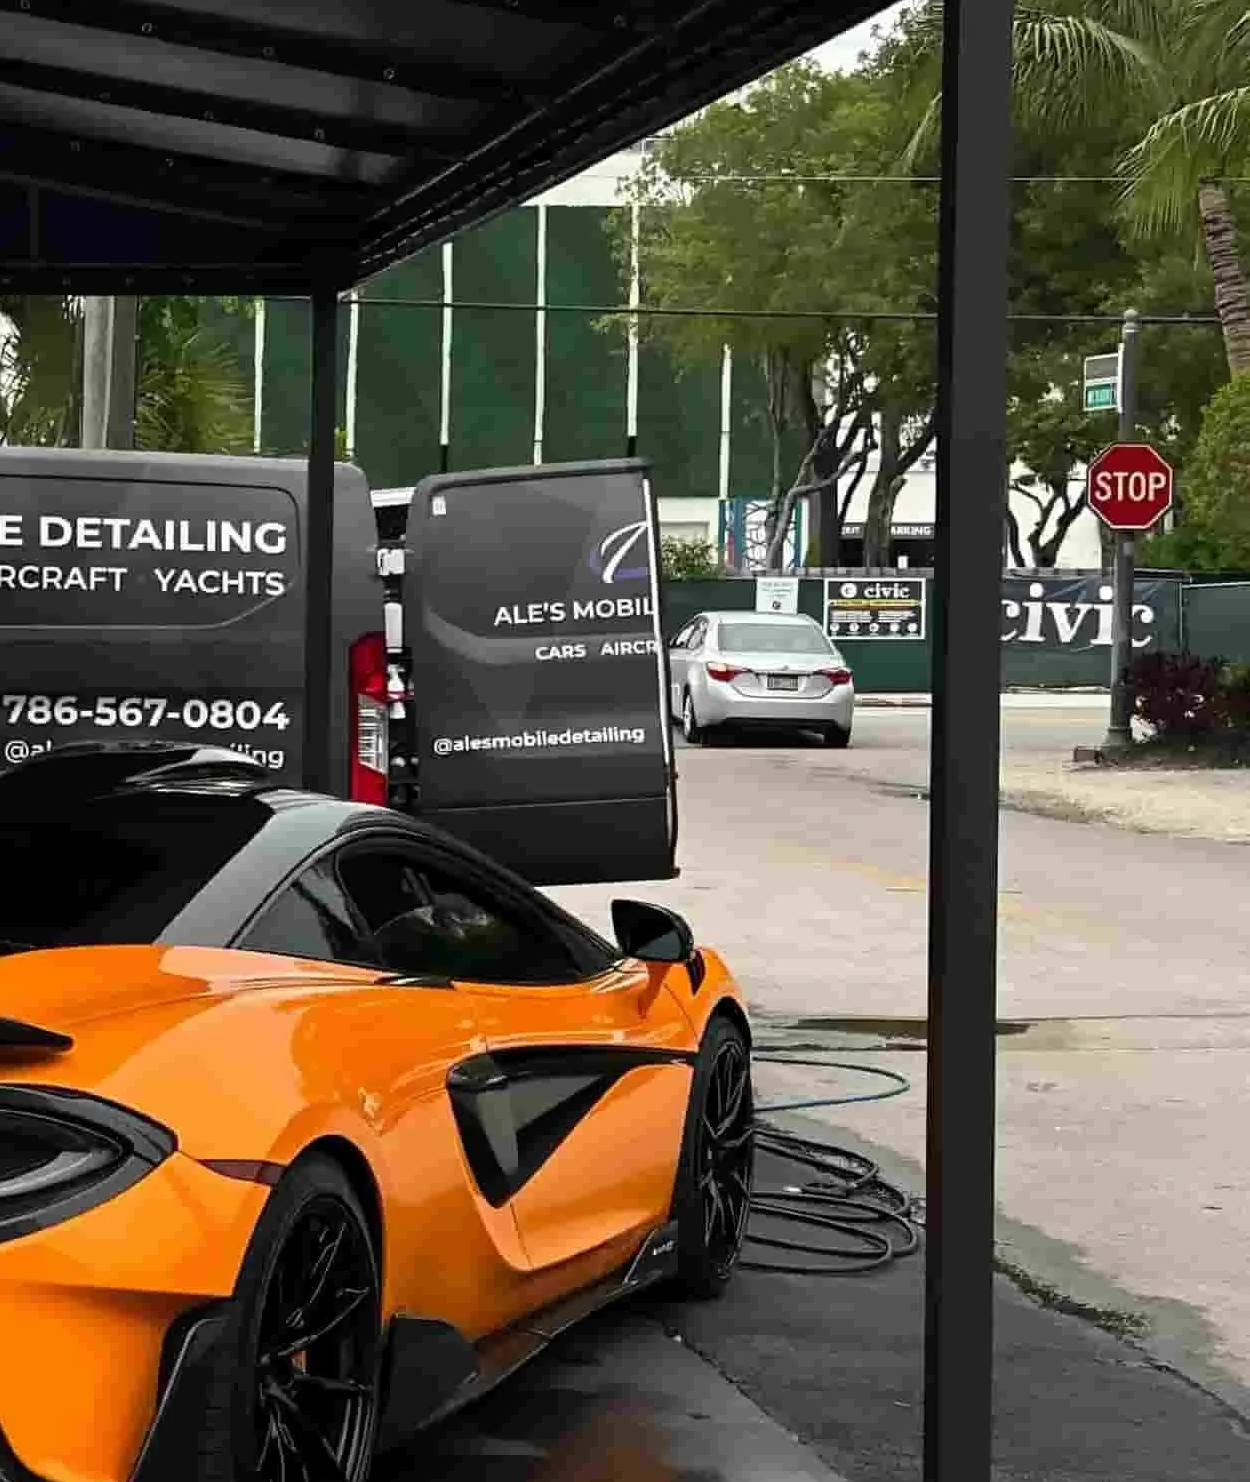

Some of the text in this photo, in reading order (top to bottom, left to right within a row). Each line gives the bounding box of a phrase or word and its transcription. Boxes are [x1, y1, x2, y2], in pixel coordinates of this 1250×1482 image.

[1095, 471, 1167, 502] STOP
[39, 515, 287, 554] DETAILING
[154, 567, 285, 597] YACHTS
[863, 582, 911, 599] civic
[493, 602, 567, 626] ALE'S
[535, 644, 587, 661] CARS
[2, 694, 291, 731] 786-567-0804
[433, 726, 646, 756] @alesmobiledetailing
